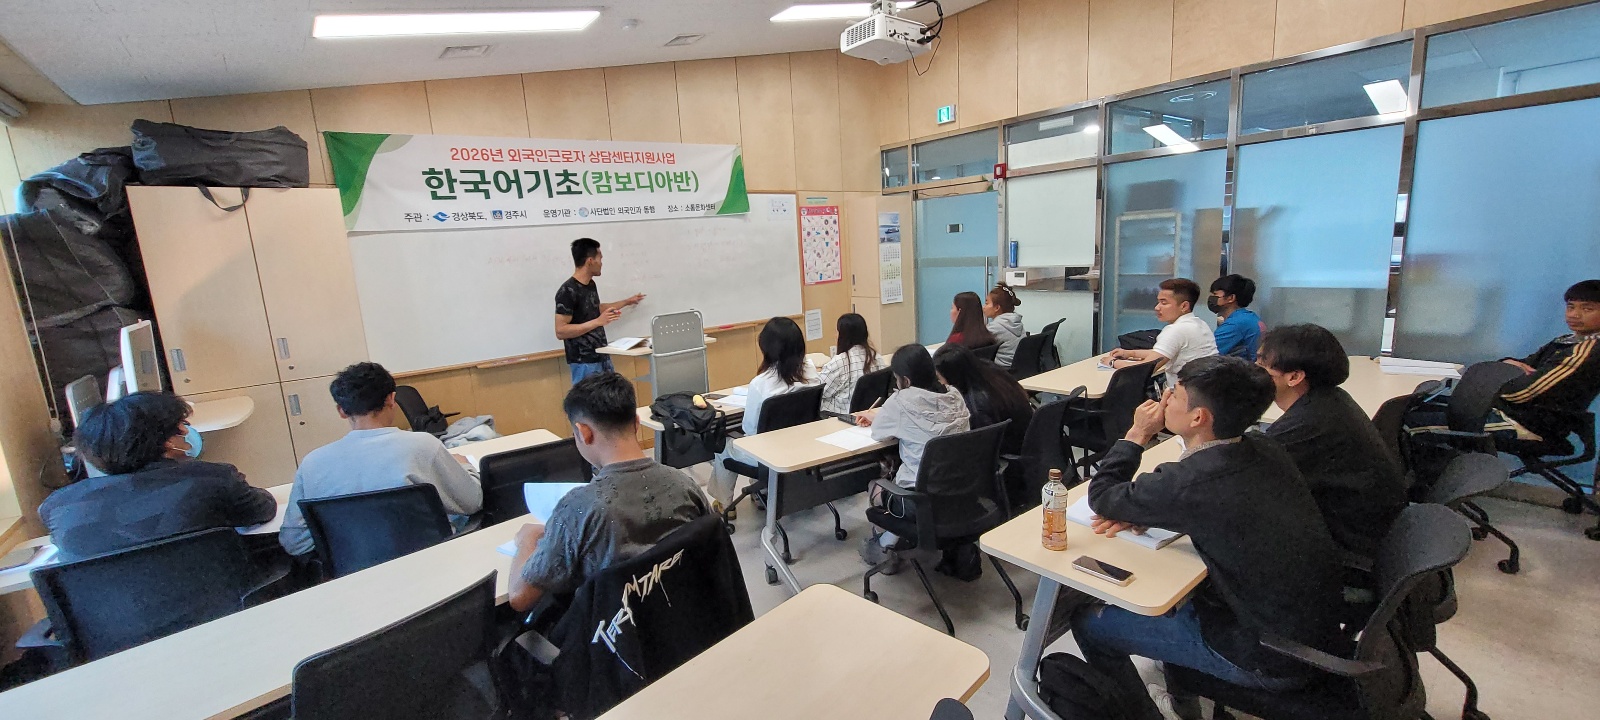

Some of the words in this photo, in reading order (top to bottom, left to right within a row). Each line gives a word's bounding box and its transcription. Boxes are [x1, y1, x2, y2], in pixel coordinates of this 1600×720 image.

[450, 147, 504, 162] 2026년
[508, 148, 585, 163] 외국인근로자
[588, 150, 676, 165] 상담센터지원사업
[421, 167, 700, 201] 한국어기초(캄보디아반)
[543, 208, 571, 218] 운영기관
[590, 207, 616, 216] 사단법인
[667, 204, 679, 213] 장소
[404, 212, 423, 223] 주관
[451, 211, 488, 222] 경상북도,
[504, 209, 528, 219] 경주시
